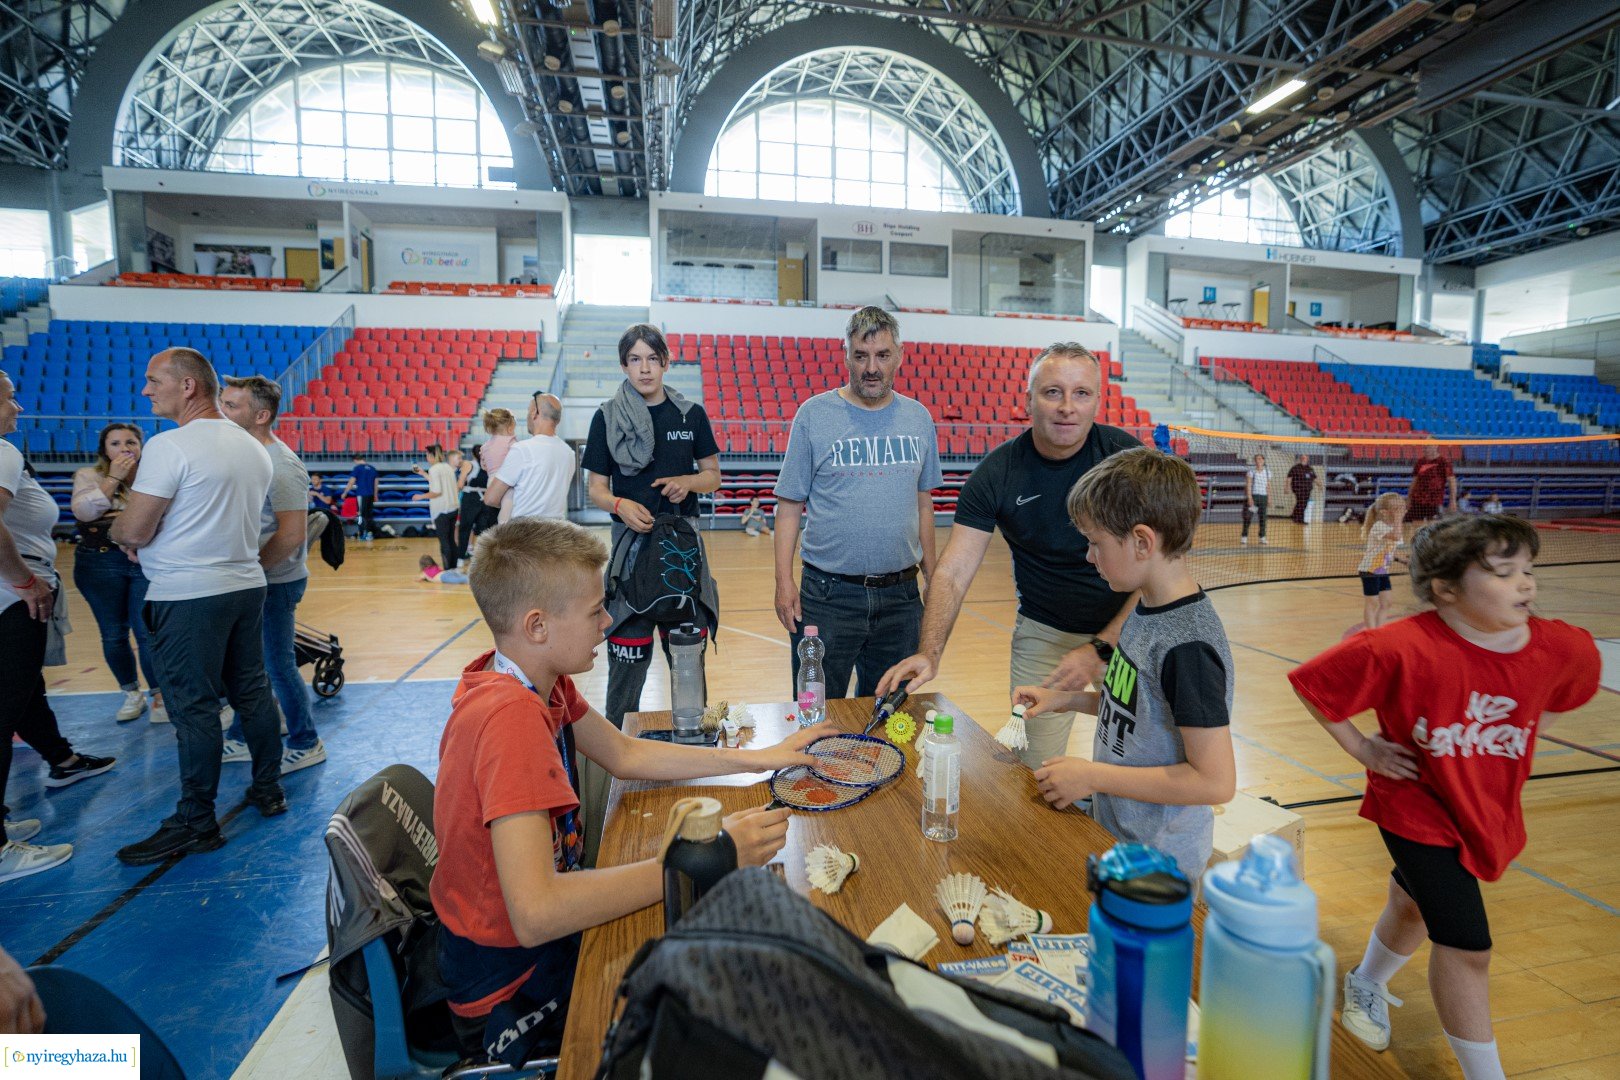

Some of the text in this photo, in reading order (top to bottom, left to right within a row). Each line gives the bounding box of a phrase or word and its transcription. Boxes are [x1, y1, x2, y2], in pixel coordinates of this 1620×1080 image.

[667, 430, 694, 441] NASA
[831, 435, 921, 467] REMAIN
[608, 643, 643, 660] HALL
